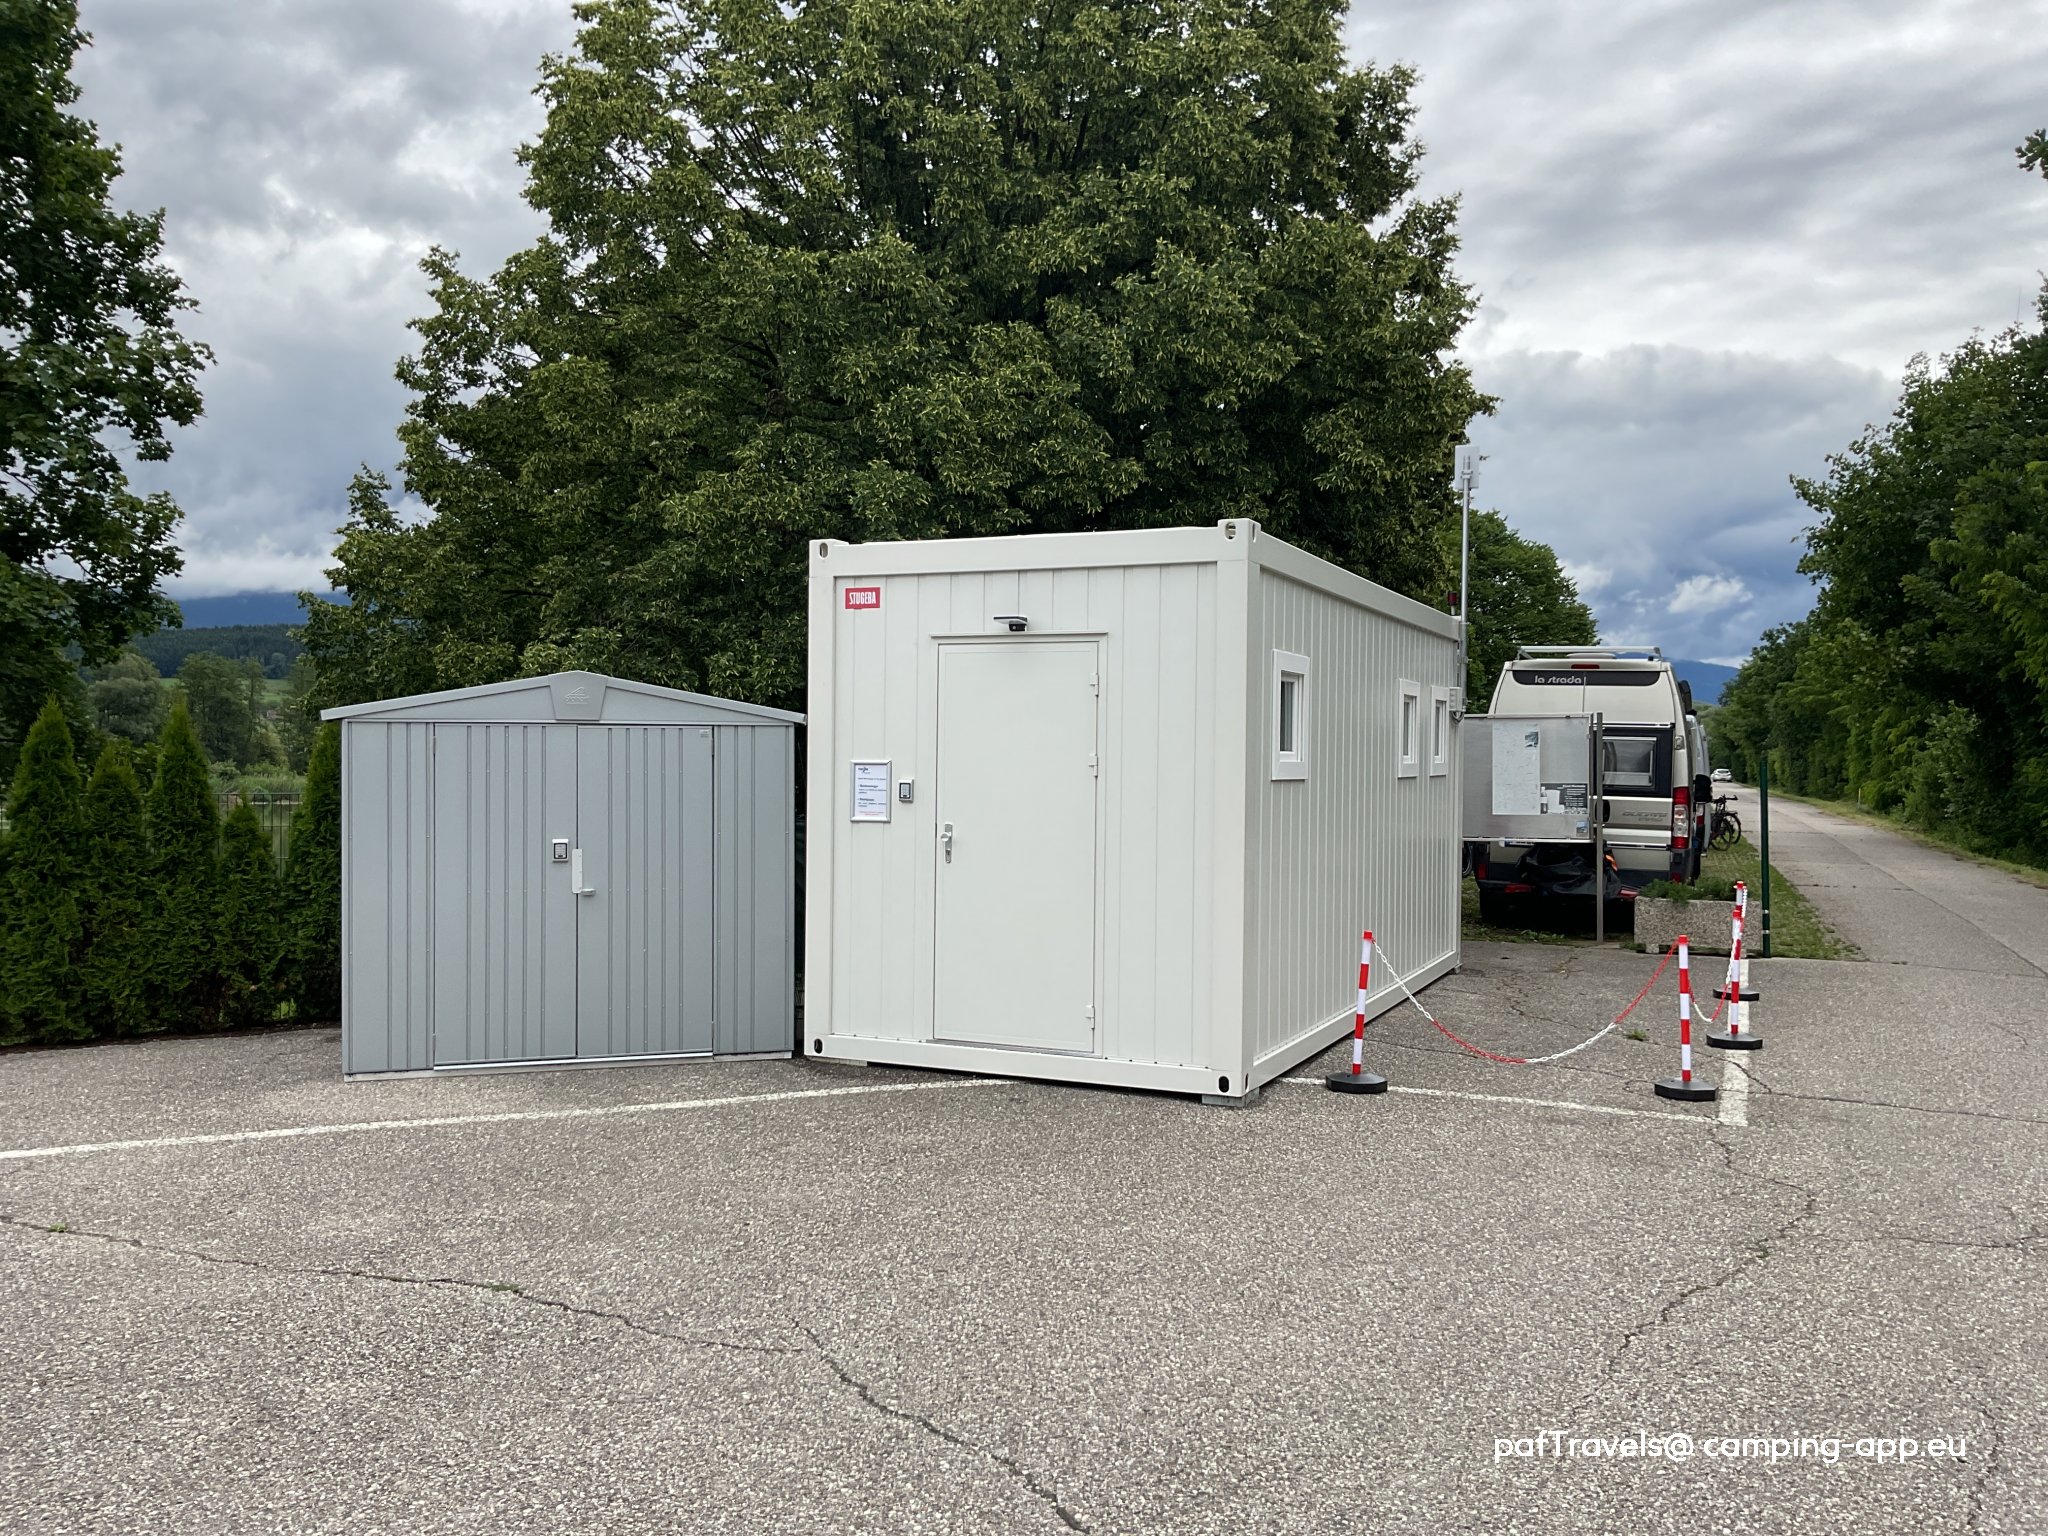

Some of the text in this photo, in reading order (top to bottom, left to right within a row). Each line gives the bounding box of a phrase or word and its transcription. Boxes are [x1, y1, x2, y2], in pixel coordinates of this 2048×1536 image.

[849, 591, 877, 605] STUGEBA
[1534, 675, 1582, 684] la strada
